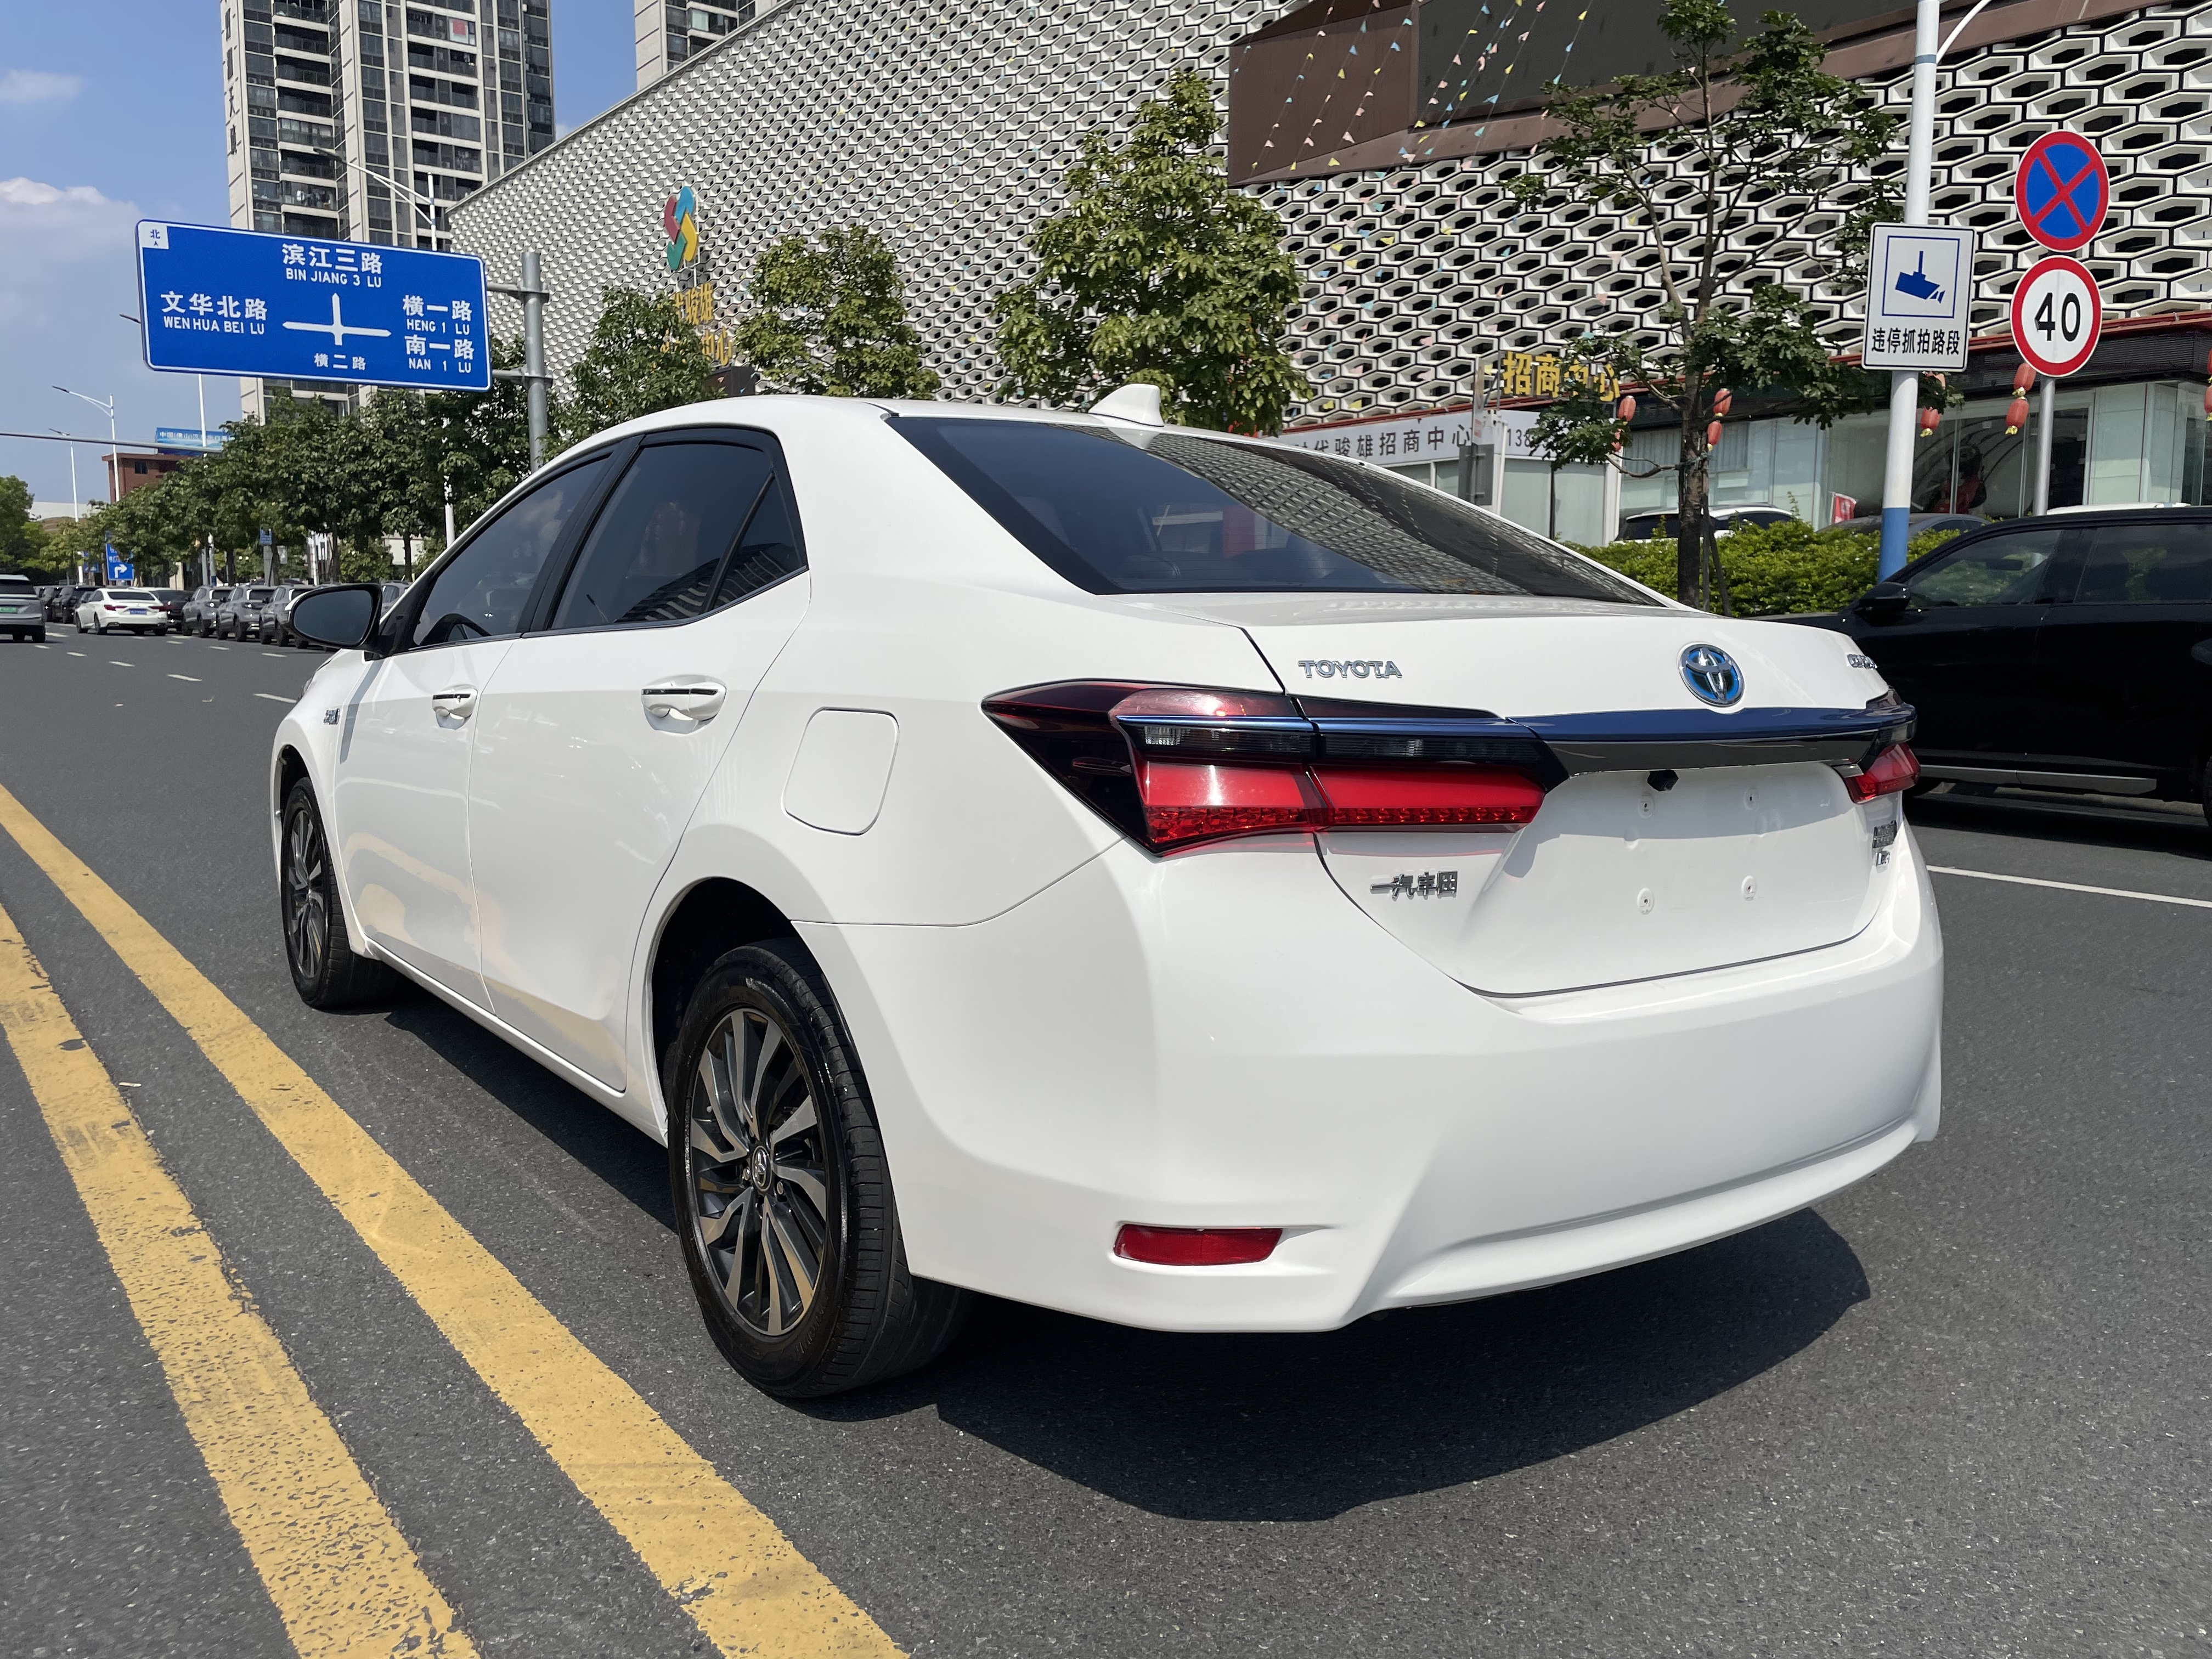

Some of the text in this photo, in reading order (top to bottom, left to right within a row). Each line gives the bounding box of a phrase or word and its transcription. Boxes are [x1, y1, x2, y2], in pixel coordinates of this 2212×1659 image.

[150, 229, 161, 239] 北
[281, 243, 383, 275] 滨江三路
[286, 267, 382, 288] BIN JIANG 3 LU
[160, 290, 268, 321] 文华北路
[402, 294, 472, 322] 横一路
[2034, 292, 2081, 342] 40
[163, 315, 264, 335] WEN HUA BEI LU
[407, 318, 470, 336] HENG 1 LU
[404, 334, 475, 360] 南一路
[1871, 327, 1960, 356] 违停抓拍路段
[314, 353, 366, 371] 横二路
[408, 357, 472, 374] NAN 1 LU
[1295, 424, 1472, 458] 代骏雄招商中心
[1297, 659, 1403, 679] TOYOTA
